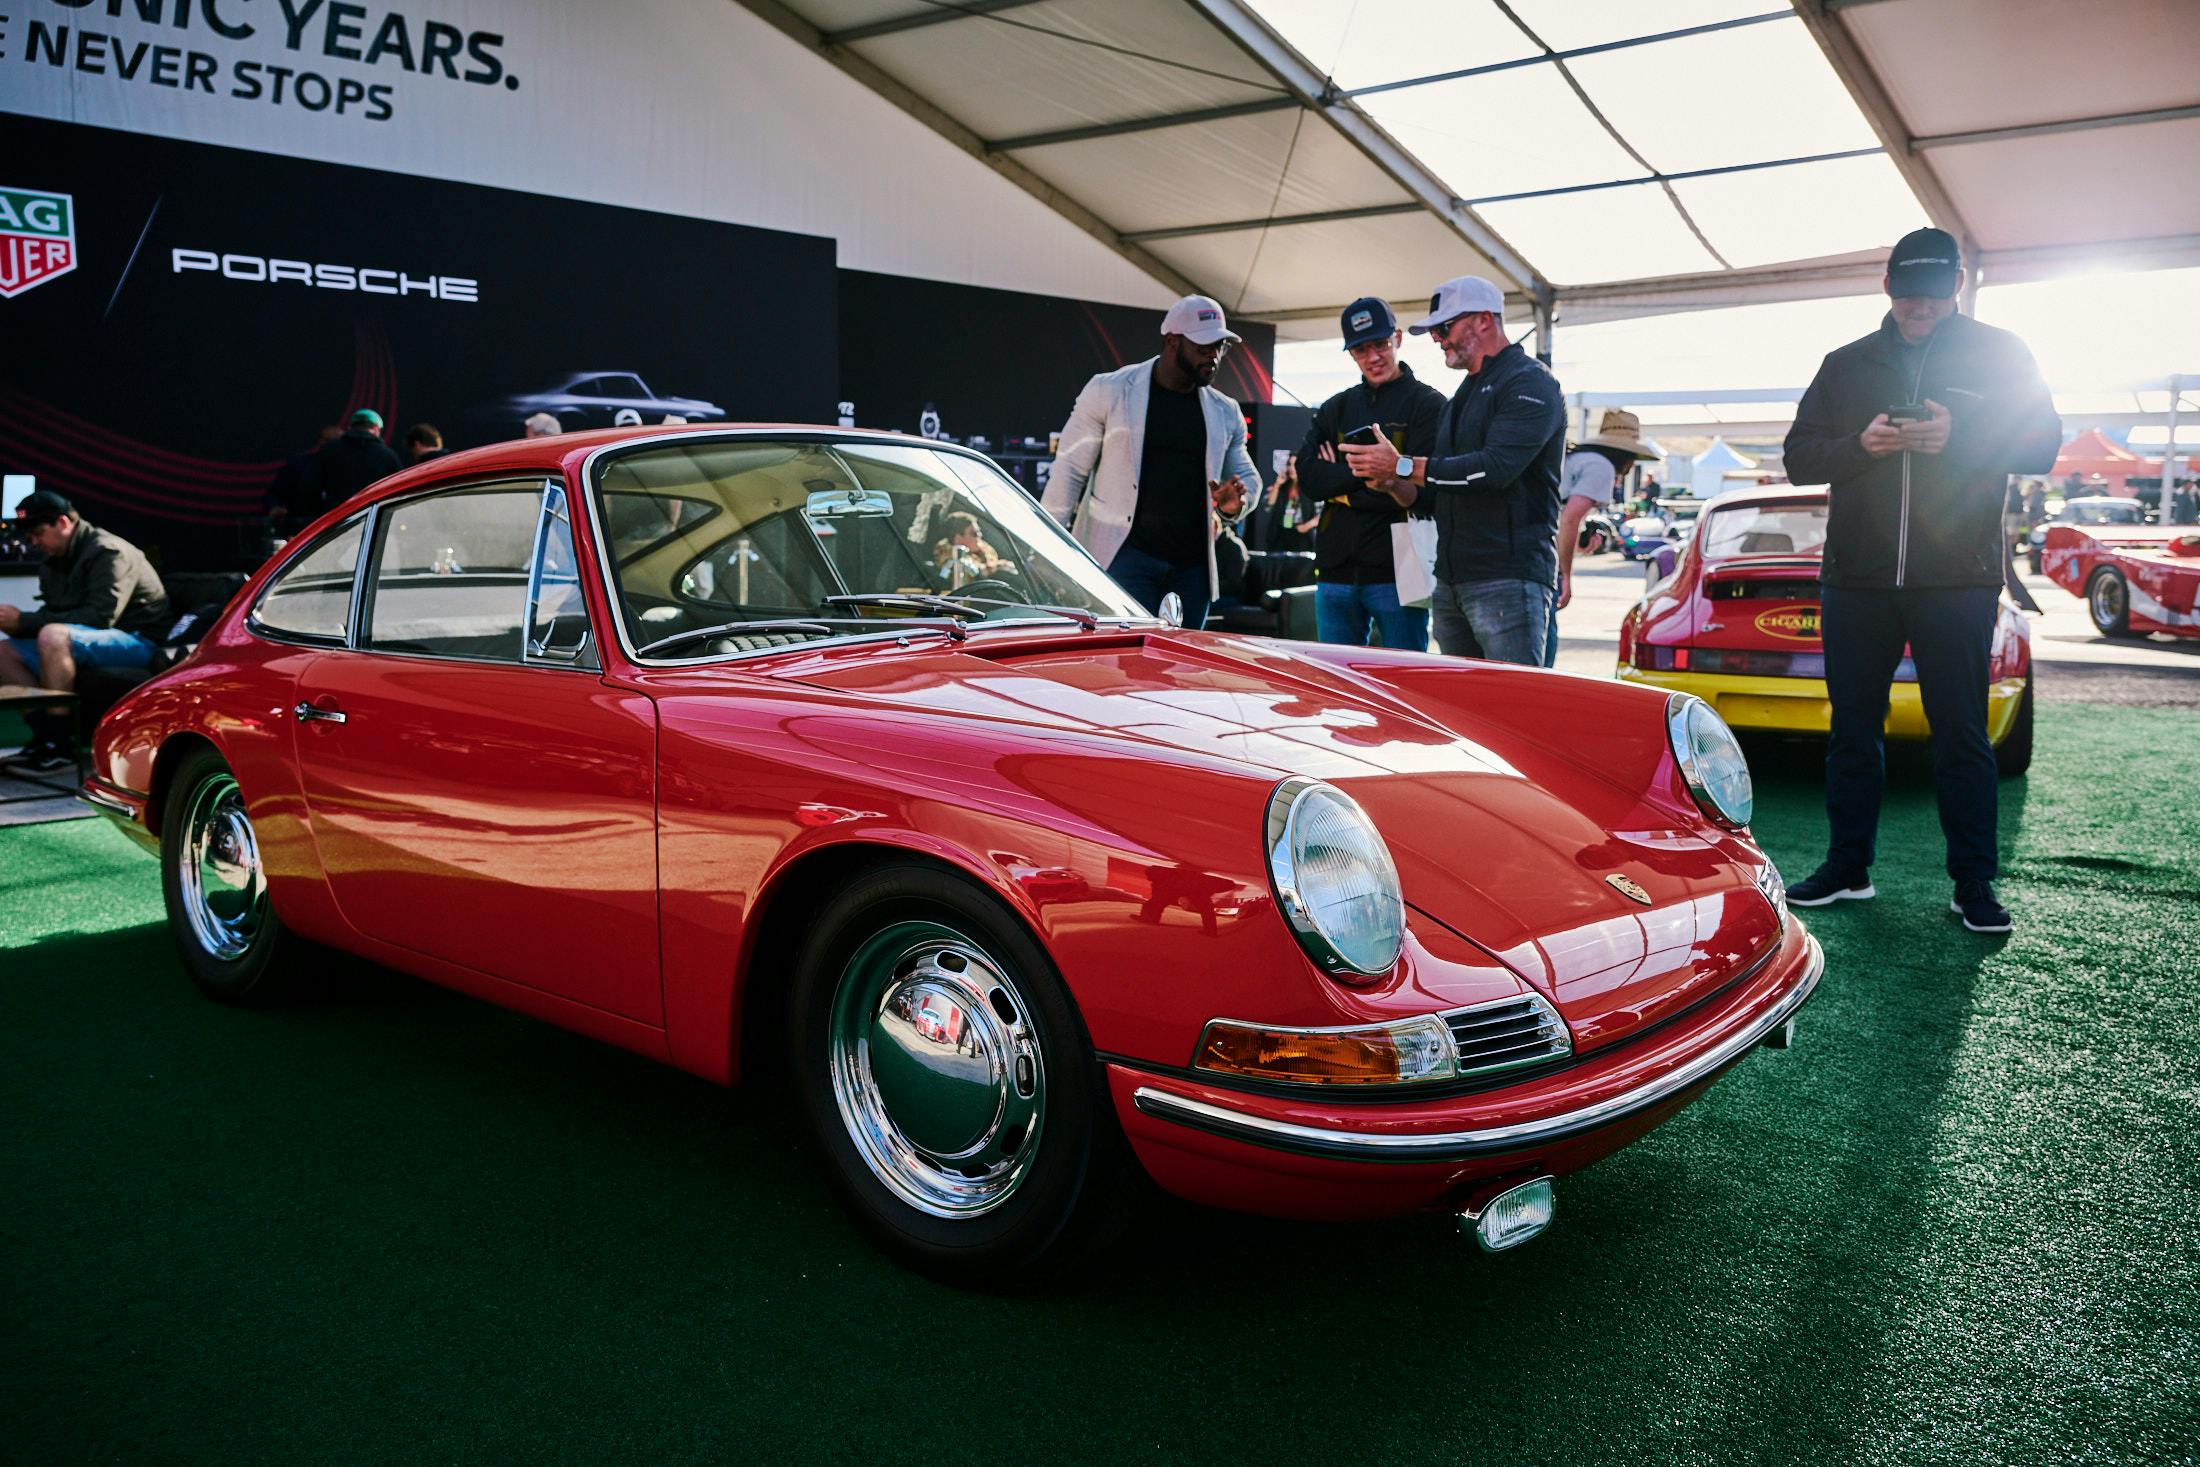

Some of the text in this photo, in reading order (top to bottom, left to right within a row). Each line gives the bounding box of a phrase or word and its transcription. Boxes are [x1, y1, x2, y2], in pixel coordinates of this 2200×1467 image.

[25, 20, 217, 94] NEVER
[231, 60, 394, 121] STOPS
[278, 0, 520, 91] YEARS.
[172, 248, 479, 302] PORSCHE
